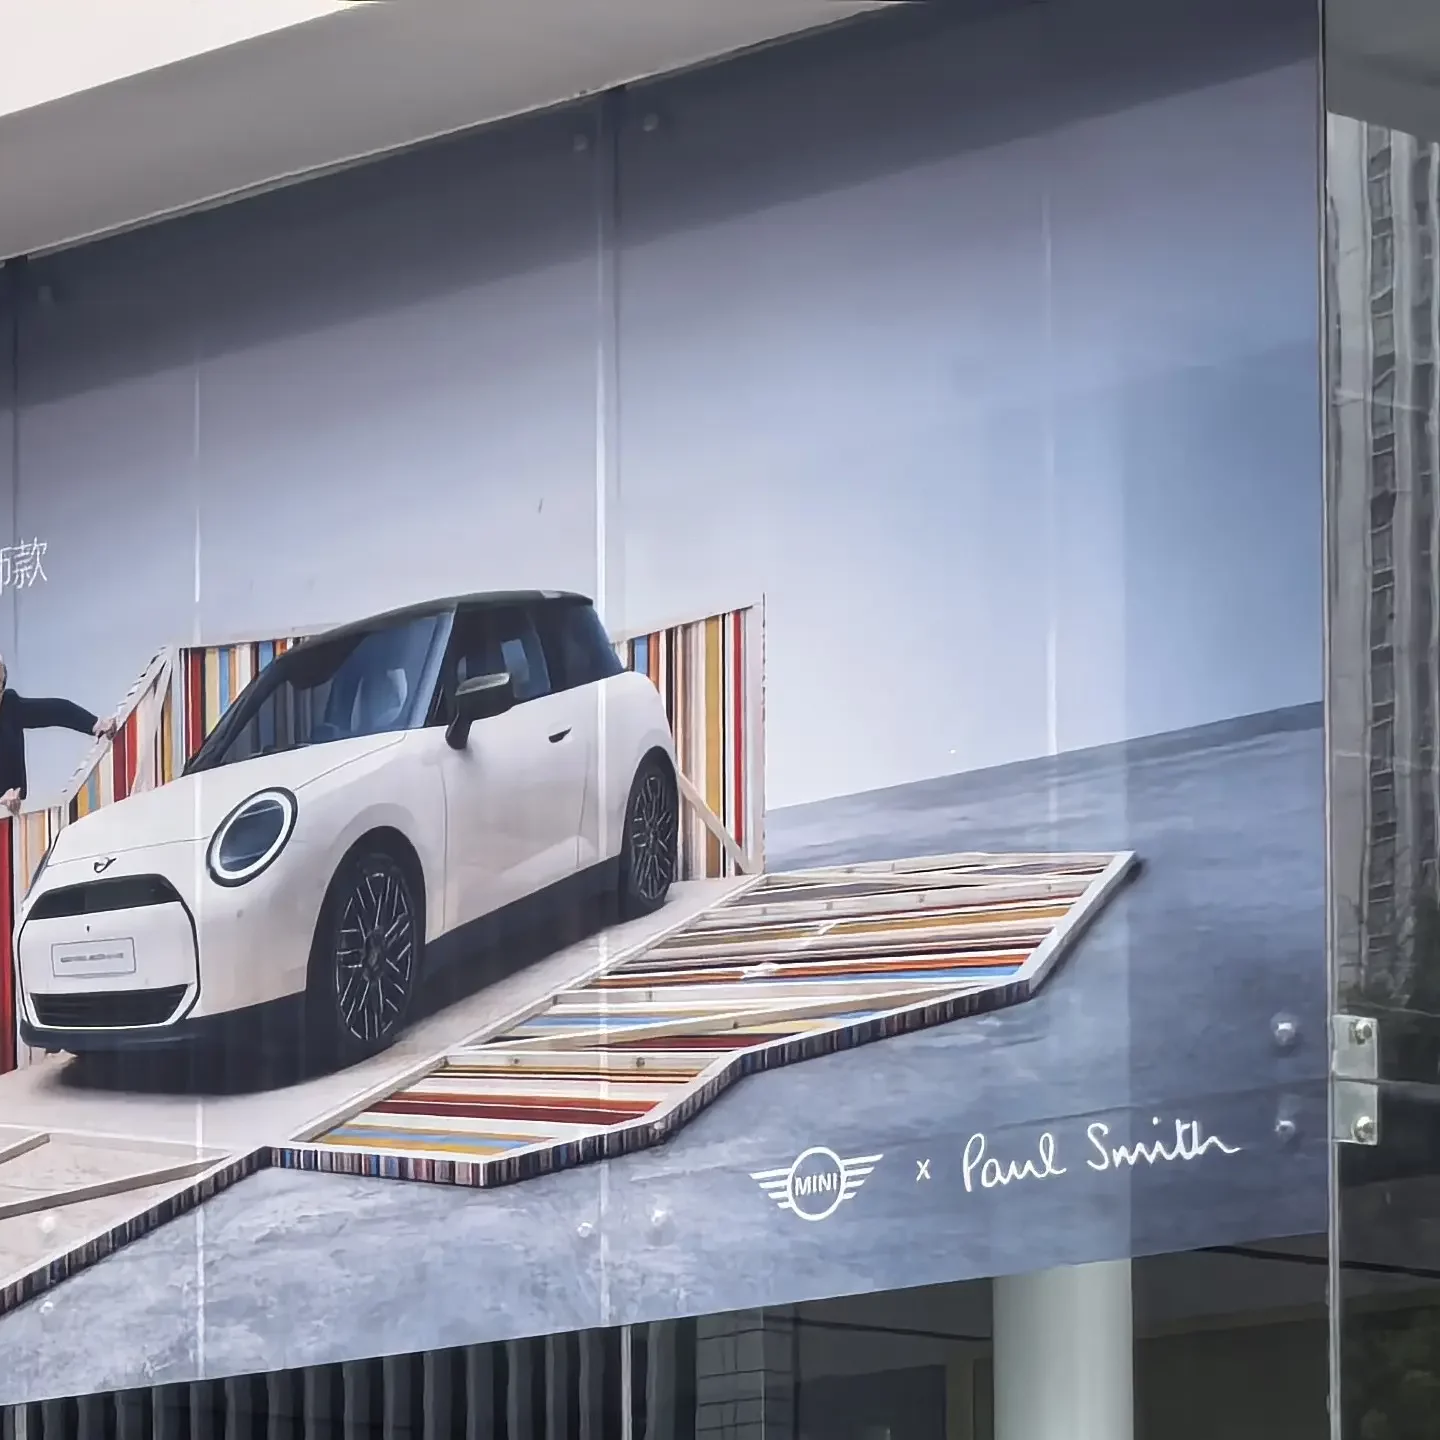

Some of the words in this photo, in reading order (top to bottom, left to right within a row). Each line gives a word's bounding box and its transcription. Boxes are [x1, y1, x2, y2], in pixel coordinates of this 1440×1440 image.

[795, 1172, 839, 1197] MINI
[962, 1133, 1068, 1193] Paul
[1087, 1117, 1241, 1172] Smith
